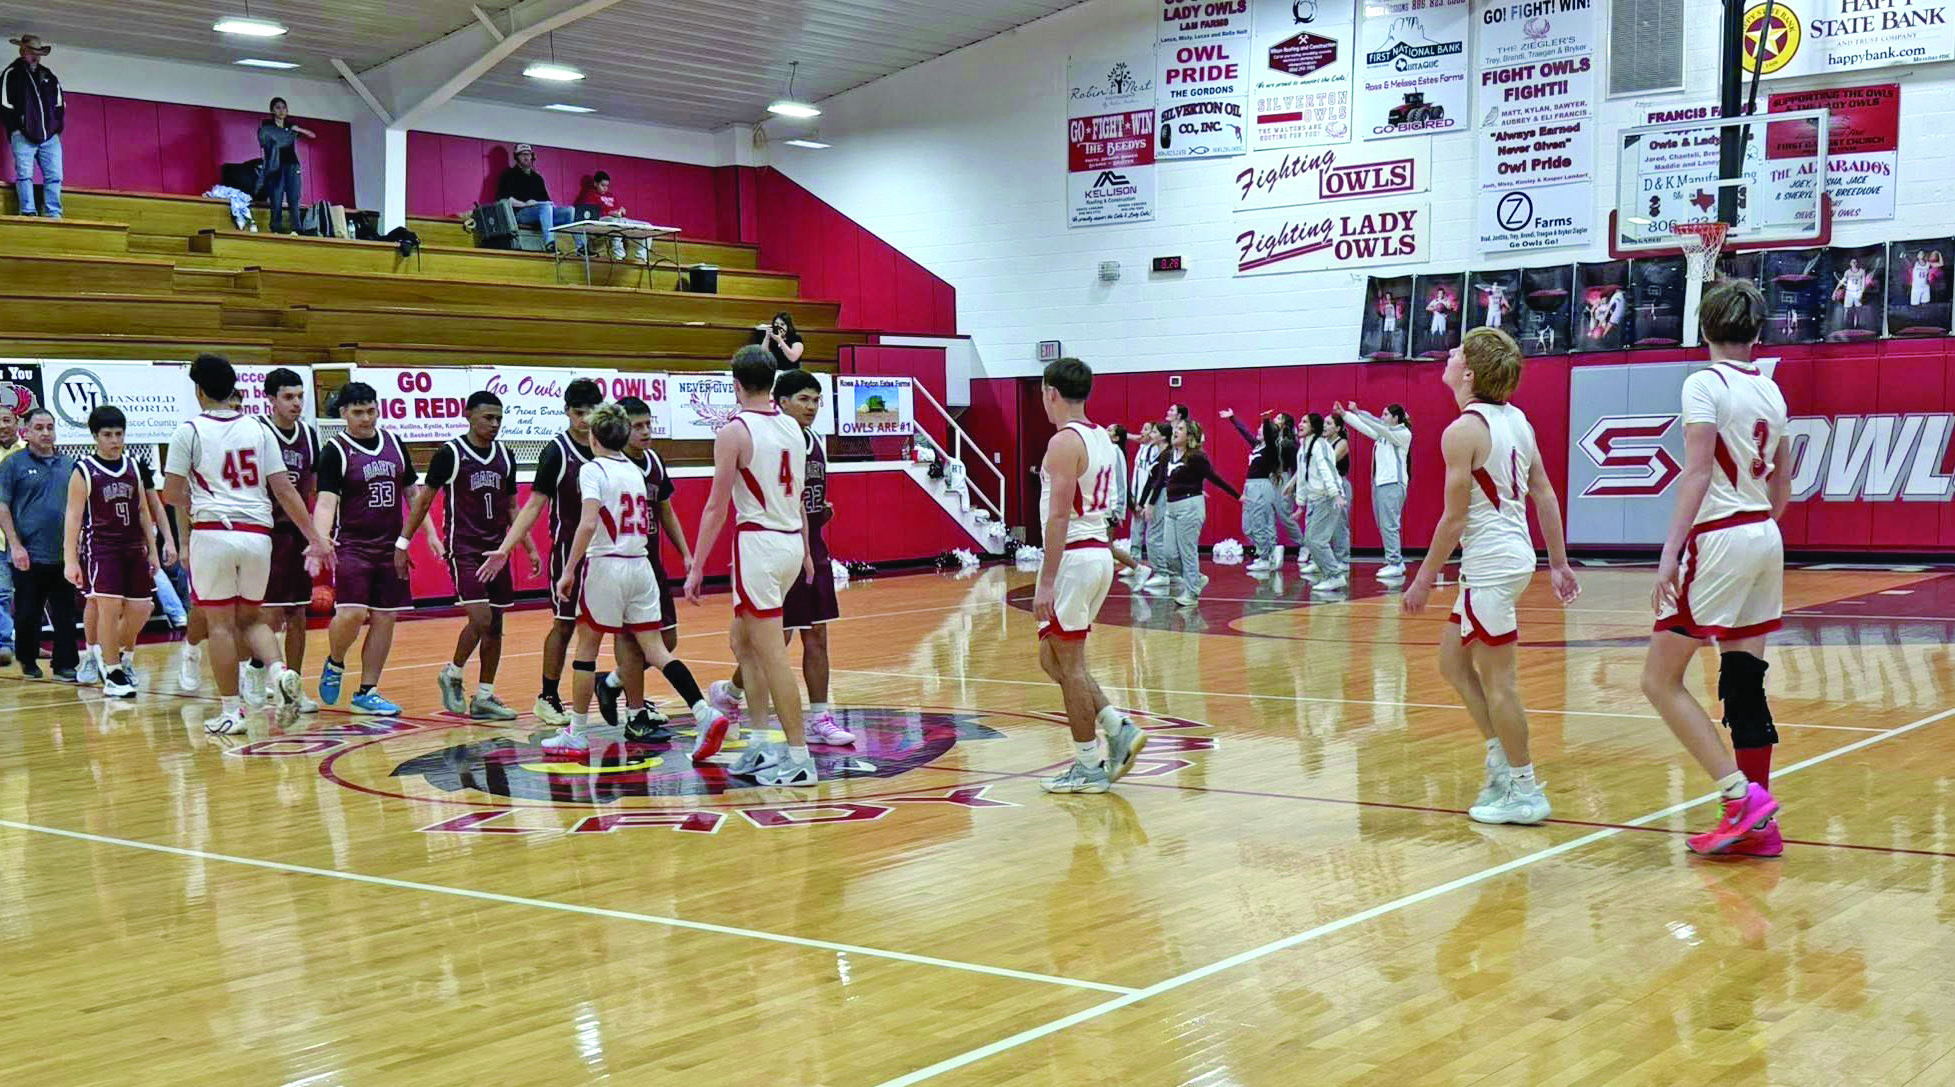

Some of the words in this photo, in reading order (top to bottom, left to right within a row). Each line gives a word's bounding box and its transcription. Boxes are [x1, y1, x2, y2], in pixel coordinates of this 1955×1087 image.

[1163, 5, 1201, 21] LADY
[1204, 0, 1247, 16] OWLS
[1483, 7, 1507, 24] GO!
[1511, 0, 1556, 20] FIGHT!
[1560, 0, 1591, 12] WIN!
[1810, 16, 1876, 39] STATE
[1881, 7, 1946, 31] BANK
[1836, 39, 1853, 48] AND
[1856, 36, 1880, 45] TRUST
[1881, 32, 1917, 43] COMPANY
[1176, 45, 1230, 63] OWL
[1369, 53, 1391, 64] FIRST
[1391, 45, 1436, 58] NATIONAL
[1437, 43, 1461, 55] BANK
[1827, 47, 1926, 66] happybank.com
[1166, 63, 1239, 84] PRIDE
[1384, 80, 1390, 89] &
[1418, 76, 1438, 85] Estes
[1439, 73, 1464, 83] Farms
[1482, 65, 1535, 86] FIGHT
[1540, 57, 1591, 77] OWLS
[1170, 89, 1188, 98] THE
[1190, 85, 1234, 97] GORDONS
[1774, 91, 1840, 106] SUPPORTING
[1843, 90, 1864, 98] THE
[1866, 88, 1894, 98] OWLS
[1257, 90, 1348, 113] SILVERTON
[1501, 110, 1522, 118] MATT,
[1525, 106, 1551, 114] KYLAN,
[1554, 101, 1587, 111] SAWYER,
[1849, 98, 1880, 108] OWLS
[1161, 101, 1224, 123] SILVERTON
[1224, 103, 1242, 117] OIL
[1303, 106, 1347, 123] OWLS
[1555, 109, 1587, 119] FRANCIS
[1647, 107, 1708, 123] FRANCIS
[1070, 120, 1086, 144] GO
[1091, 113, 1125, 140] FIGHT
[1130, 111, 1154, 137] WIN
[1372, 126, 1395, 135] GO
[1398, 121, 1424, 132] BIG
[1425, 118, 1455, 130] RED
[1538, 122, 1580, 136] Earned
[1077, 141, 1104, 155] THE
[1106, 139, 1147, 157] BEEDYS
[1497, 145, 1531, 156] Never
[1650, 139, 1679, 150] Owls
[1681, 137, 1691, 147] &
[1694, 134, 1722, 146] Lady
[1846, 137, 1885, 146] CHURCH
[1497, 160, 1527, 175] Owl
[1531, 155, 1572, 171] Pride
[1771, 168, 1792, 183] THE
[1798, 159, 1891, 176] ALARADO'S
[1235, 149, 1336, 201] Fighting
[1325, 164, 1408, 194] OWLS
[1847, 175, 1869, 185] JACE
[1085, 186, 1137, 199] KELLISON
[1784, 189, 1813, 200] SHERYL
[1836, 185, 1883, 198] BREEDLOVE
[1838, 207, 1861, 218] OWLS
[1535, 216, 1573, 229] Farms
[1235, 217, 1334, 262] Fighting
[1339, 210, 1418, 237] LADY
[1523, 238, 1543, 246] Owls
[1544, 237, 1559, 245] Go!
[1334, 234, 1416, 261] OWLS
[397, 371, 432, 393] GO
[486, 374, 509, 396] Go
[517, 376, 562, 399] Owls
[612, 377, 667, 402] OWLS!
[679, 381, 712, 393] NEVER
[714, 381, 735, 393] GIVE
[102, 395, 176, 404] MANGOLD
[504, 405, 511, 415] &
[147, 416, 177, 430] County
[517, 417, 533, 425] and
[842, 422, 874, 434] OWLS
[877, 422, 897, 433] ARE
[900, 421, 911, 433] #1
[1748, 417, 1770, 479] 3
[1783, 413, 1955, 503] OWL
[221, 447, 260, 490] 45
[362, 460, 398, 481] HART
[777, 448, 794, 498] 4
[1510, 446, 1520, 500] 1
[470, 475, 503, 492] HART
[1089, 464, 1112, 512] 11
[368, 480, 396, 508] 33
[115, 502, 130, 525] 4
[484, 492, 494, 519] 1
[619, 491, 650, 536] 23
[415, 784, 1025, 834] LADY
